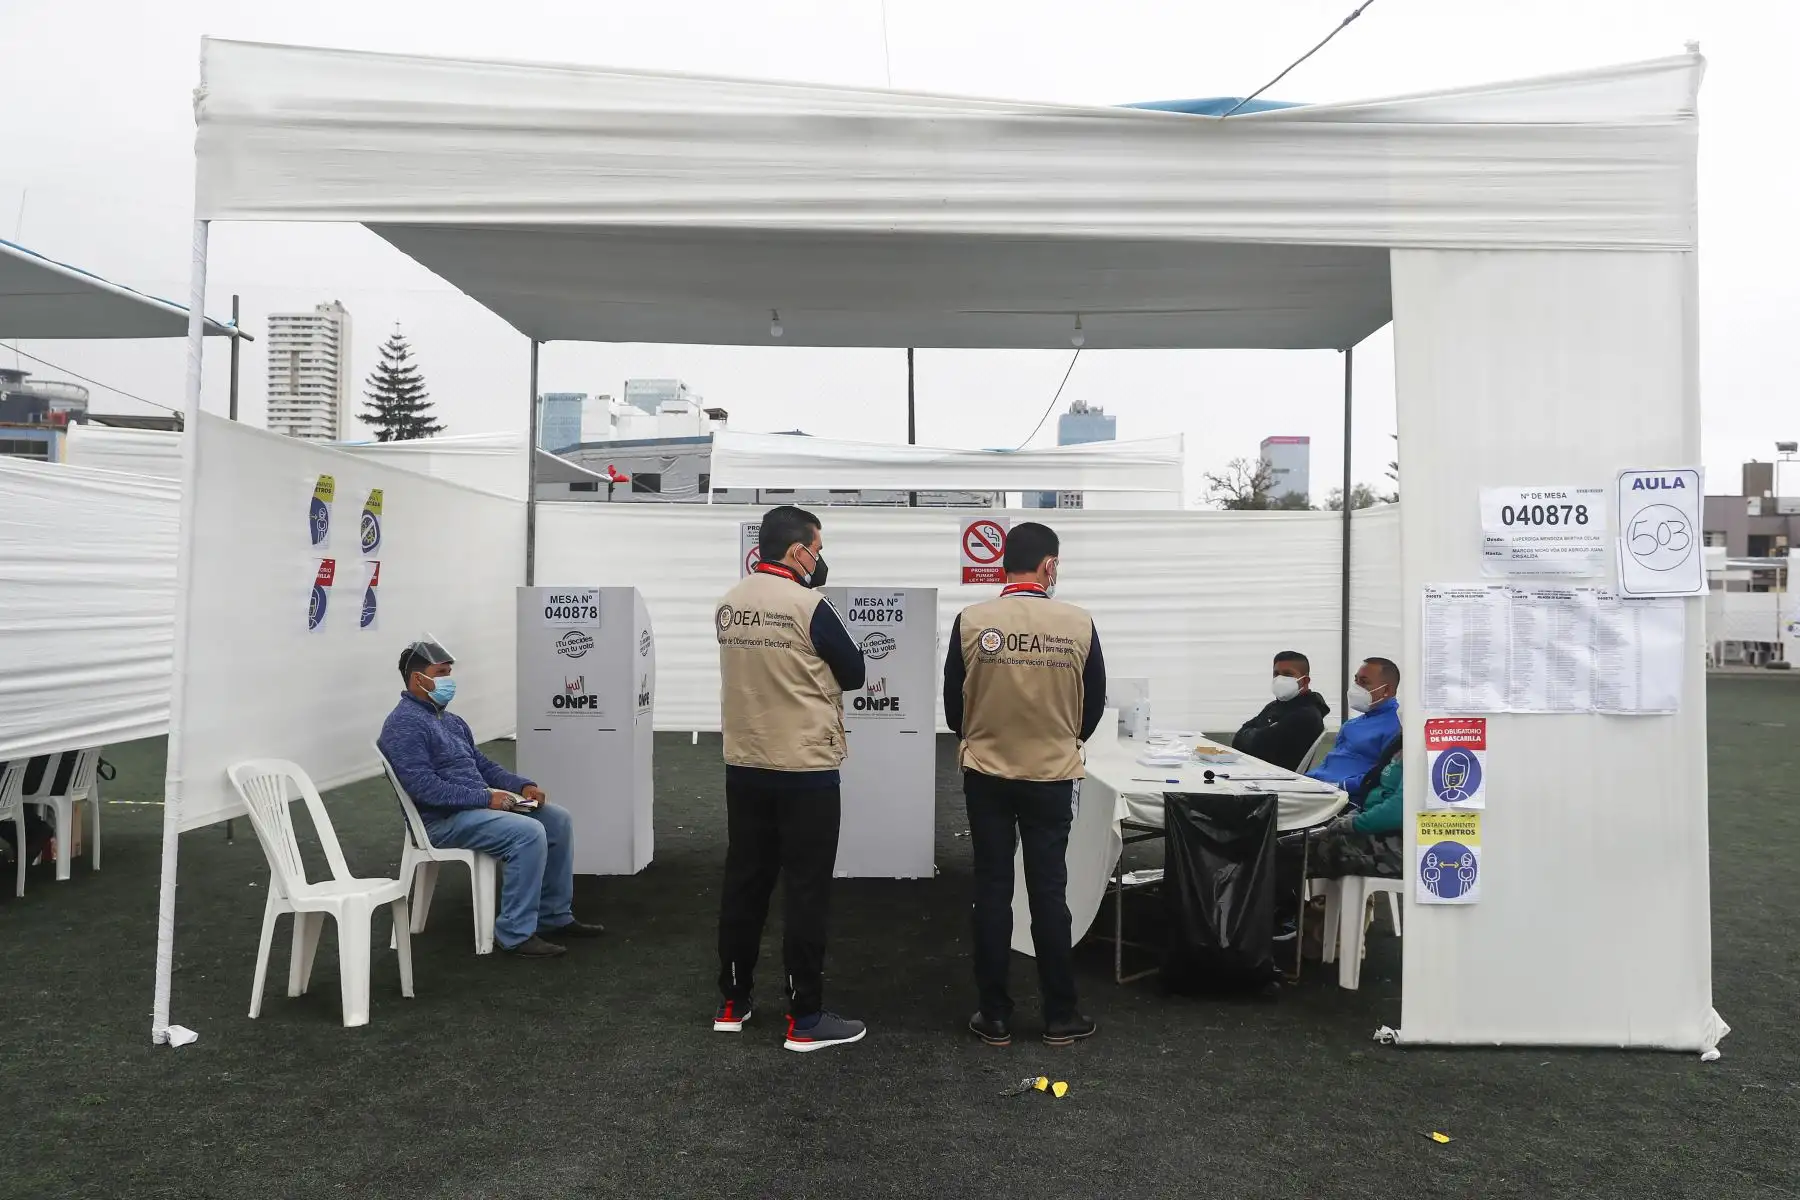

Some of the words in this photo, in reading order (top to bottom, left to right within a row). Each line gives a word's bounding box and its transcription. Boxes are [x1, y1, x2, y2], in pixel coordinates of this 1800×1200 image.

[1632, 476, 1686, 490] AULA
[1501, 504, 1588, 526] 040878
[1632, 520, 1690, 556] 503
[550, 596, 580, 604] MESA
[854, 598, 884, 606] MESA
[544, 606, 598, 619] 040878
[734, 610, 760, 626] OEA
[848, 609, 903, 622] 040878
[568, 636, 593, 646] decides
[764, 639, 792, 648] Electoral
[869, 637, 896, 647] decides
[1006, 633, 1041, 652] OEA
[1006, 657, 1044, 666] Observación
[1046, 660, 1072, 668] Electoral
[552, 694, 598, 709] ONPE
[853, 696, 900, 711] ONPE
